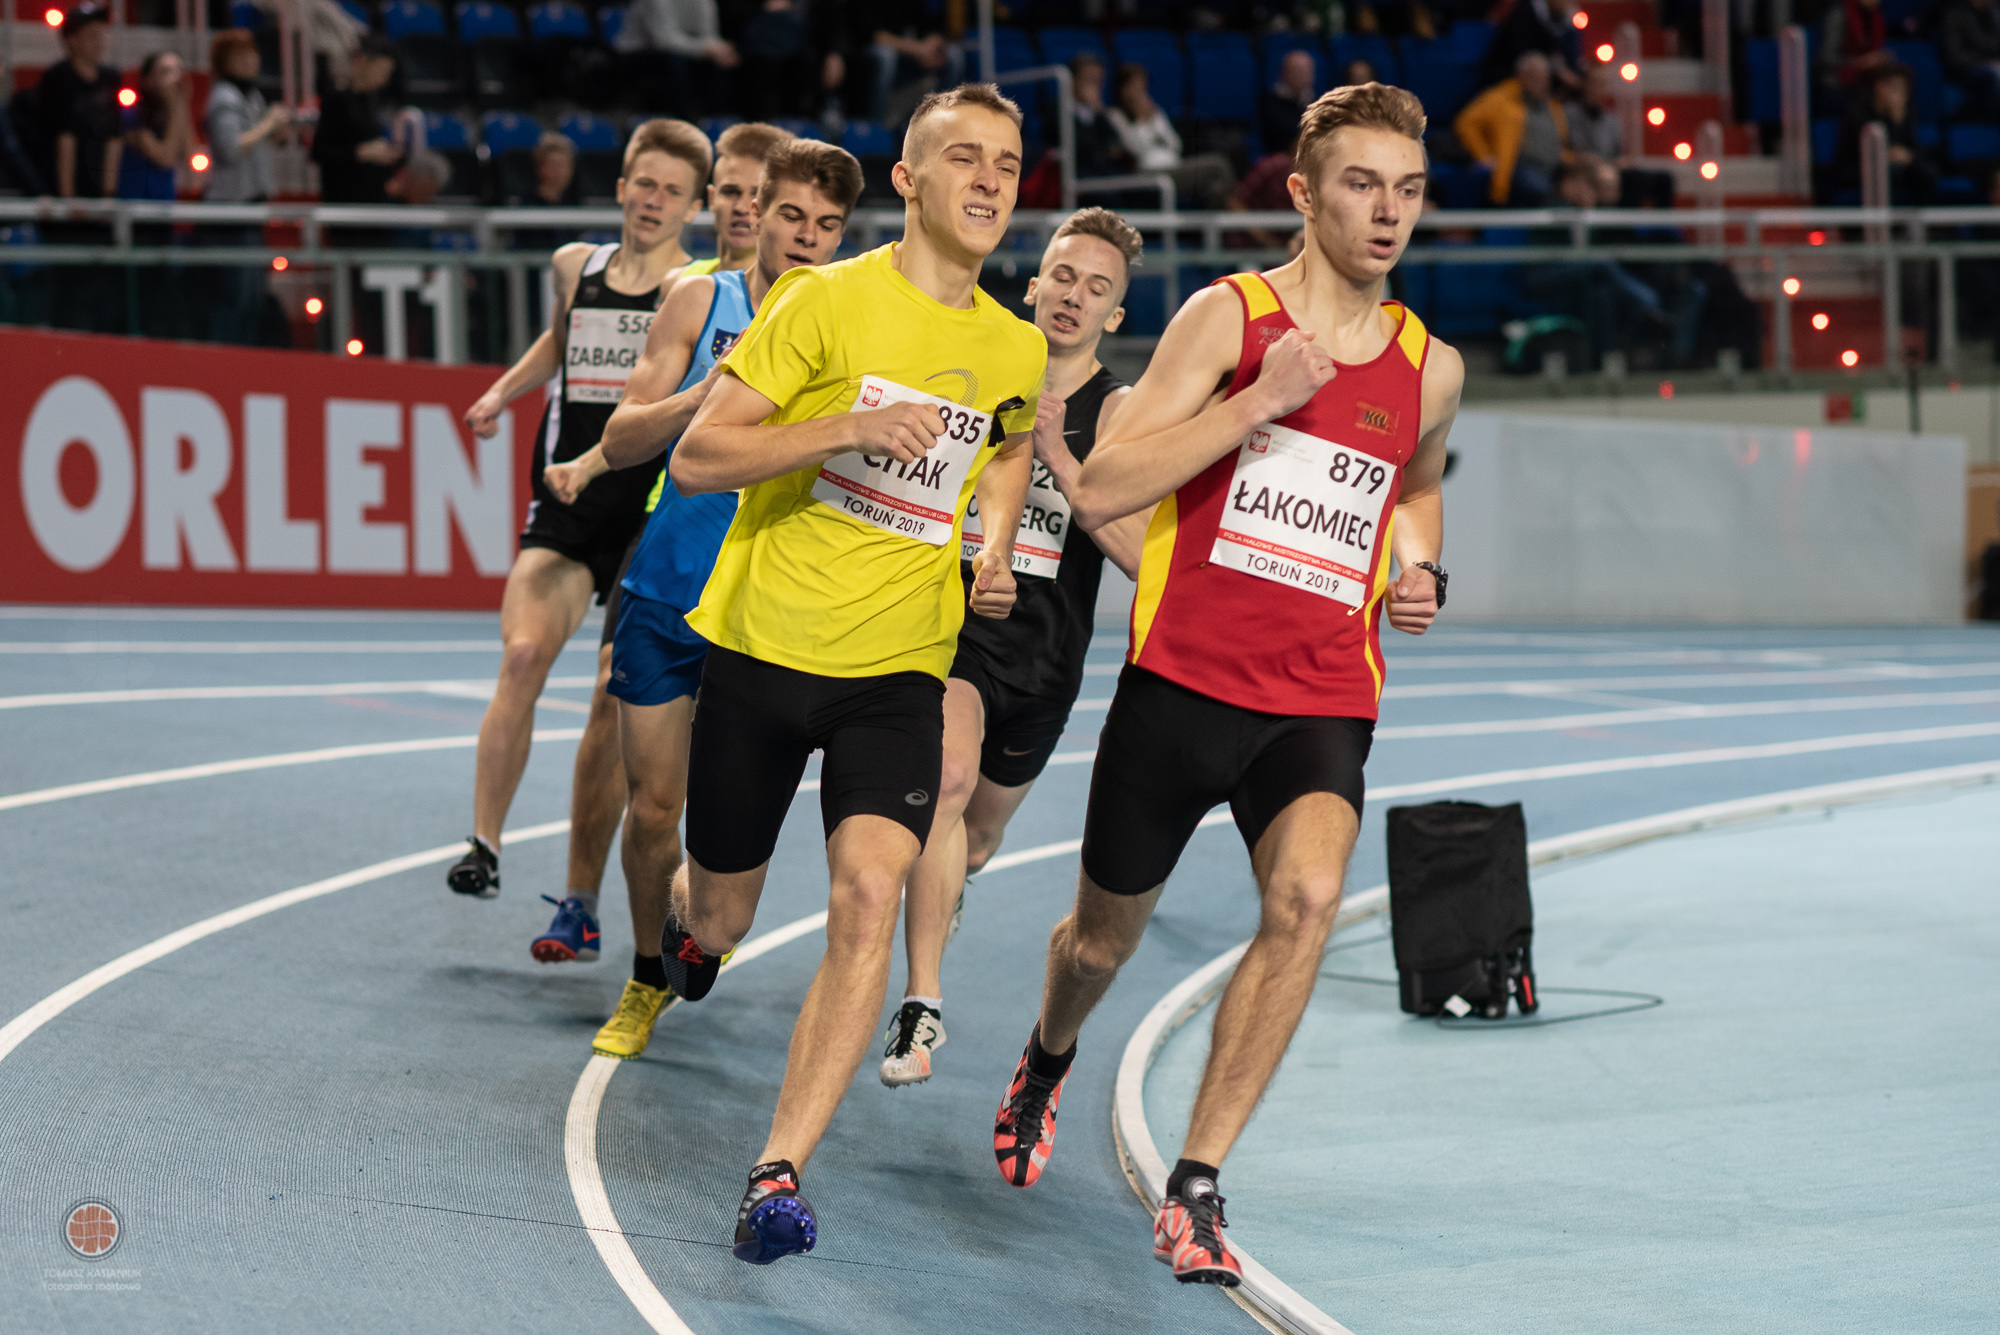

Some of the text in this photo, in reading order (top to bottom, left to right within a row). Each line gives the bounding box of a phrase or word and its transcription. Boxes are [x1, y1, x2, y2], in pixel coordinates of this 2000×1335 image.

[938, 405, 986, 445] 835
[20, 374, 514, 577] ORLEN
[824, 472, 842, 484] PZLA
[843, 480, 870, 497] HALOWE
[870, 491, 913, 512] MISTRZOSTWA
[1328, 451, 1386, 495] 879
[843, 495, 926, 536] TORUŃ 2019
[1233, 480, 1372, 551] ŁAKOMIEC
[1243, 536, 1273, 551] HALOWE
[1247, 553, 1340, 593] TORUŃ 2019
